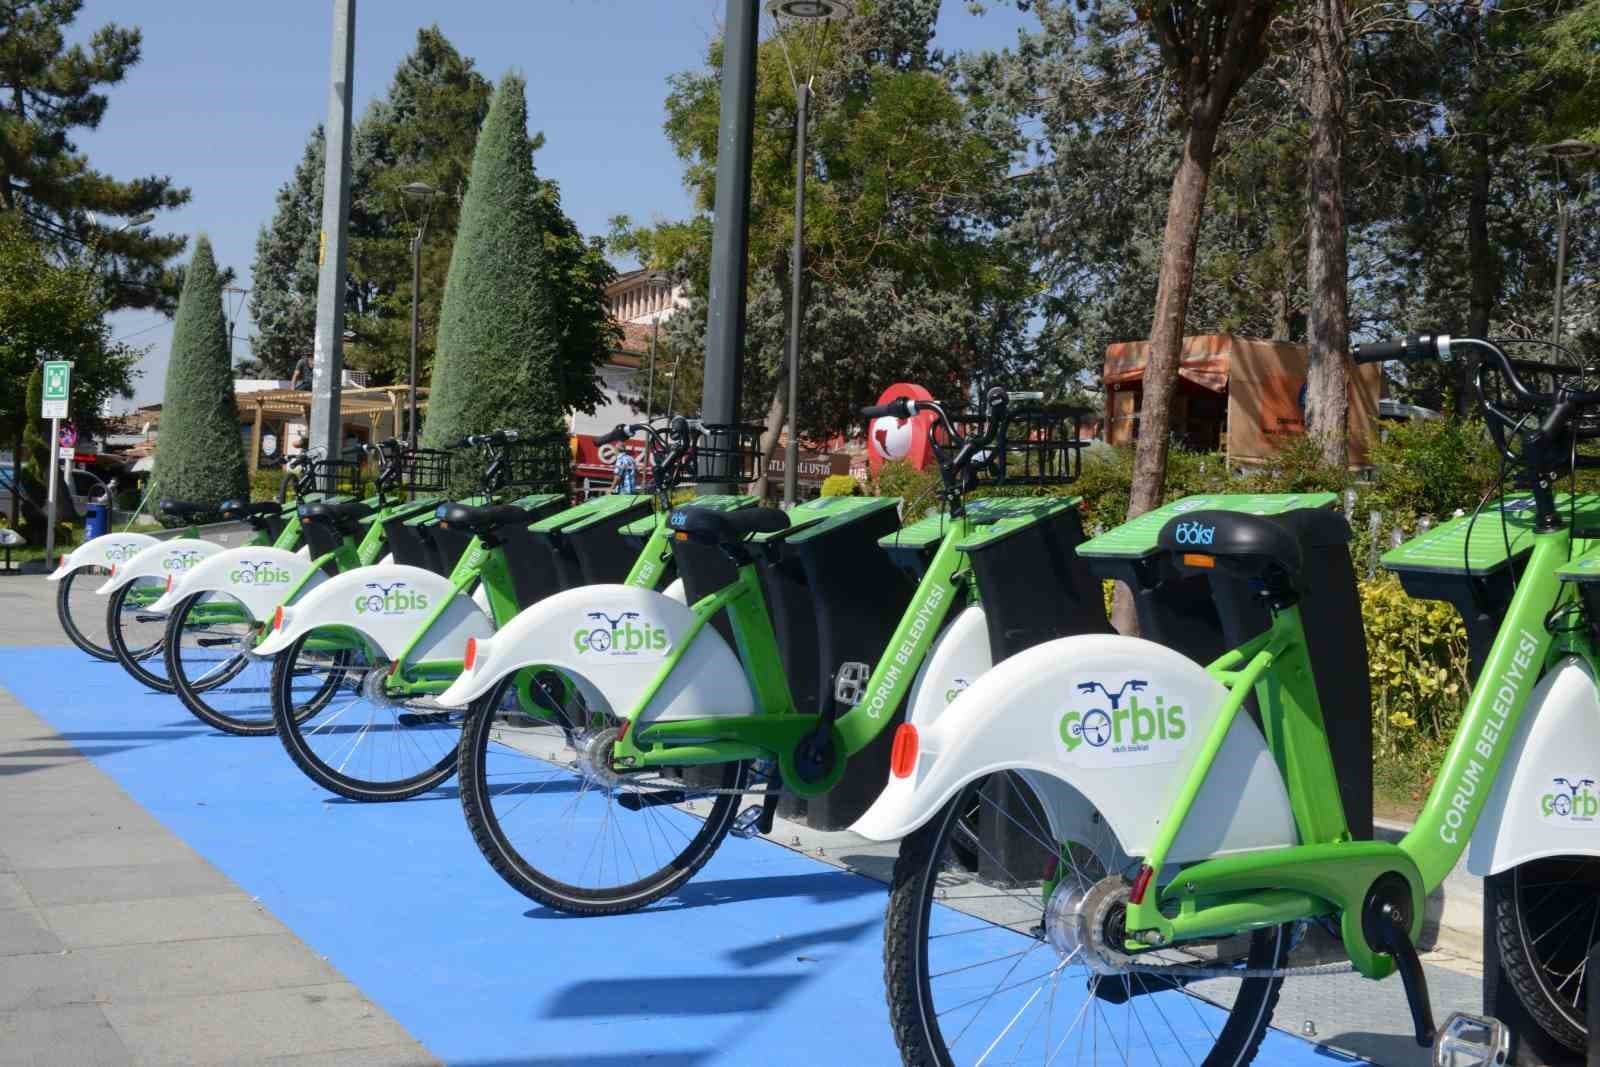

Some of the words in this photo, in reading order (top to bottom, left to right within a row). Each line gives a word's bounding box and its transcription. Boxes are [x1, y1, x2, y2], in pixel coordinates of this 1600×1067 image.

[355, 589, 428, 614] çorbis
[574, 622, 667, 654] çorbis
[867, 665, 901, 720] ÇORUM
[896, 582, 946, 665] BELEDİYESİ
[1059, 695, 1186, 752] çorbis
[1440, 759, 1485, 844] ÇORUM
[1475, 629, 1539, 760] BELEDİYESİ
[1541, 788, 1600, 816] çorb
